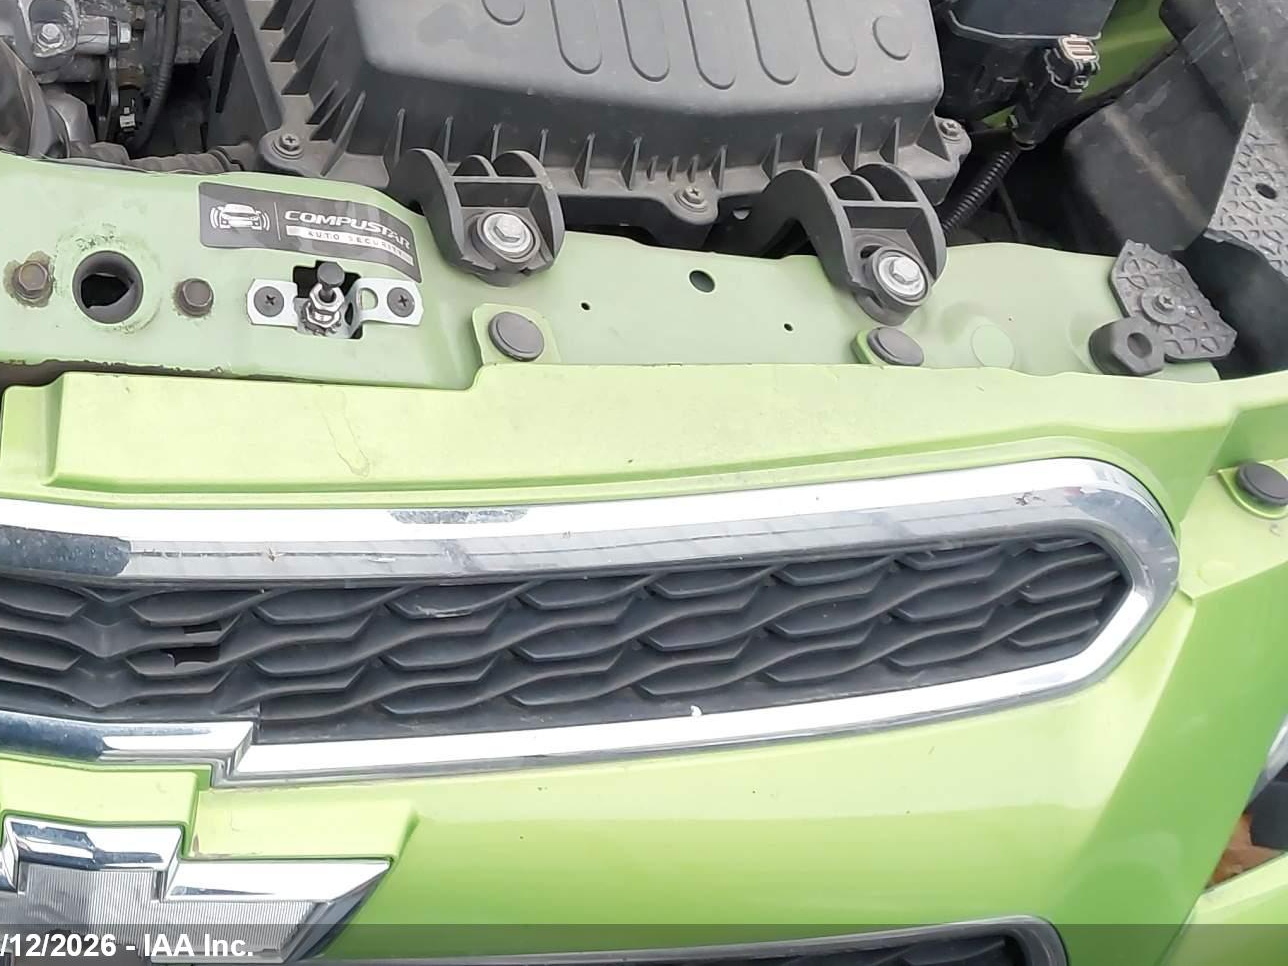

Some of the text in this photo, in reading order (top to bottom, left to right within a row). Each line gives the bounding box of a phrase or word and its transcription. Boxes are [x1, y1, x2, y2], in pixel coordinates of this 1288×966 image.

[284, 210, 411, 250] COMPUSTAR
[307, 231, 403, 257] AUTO SECURITY
